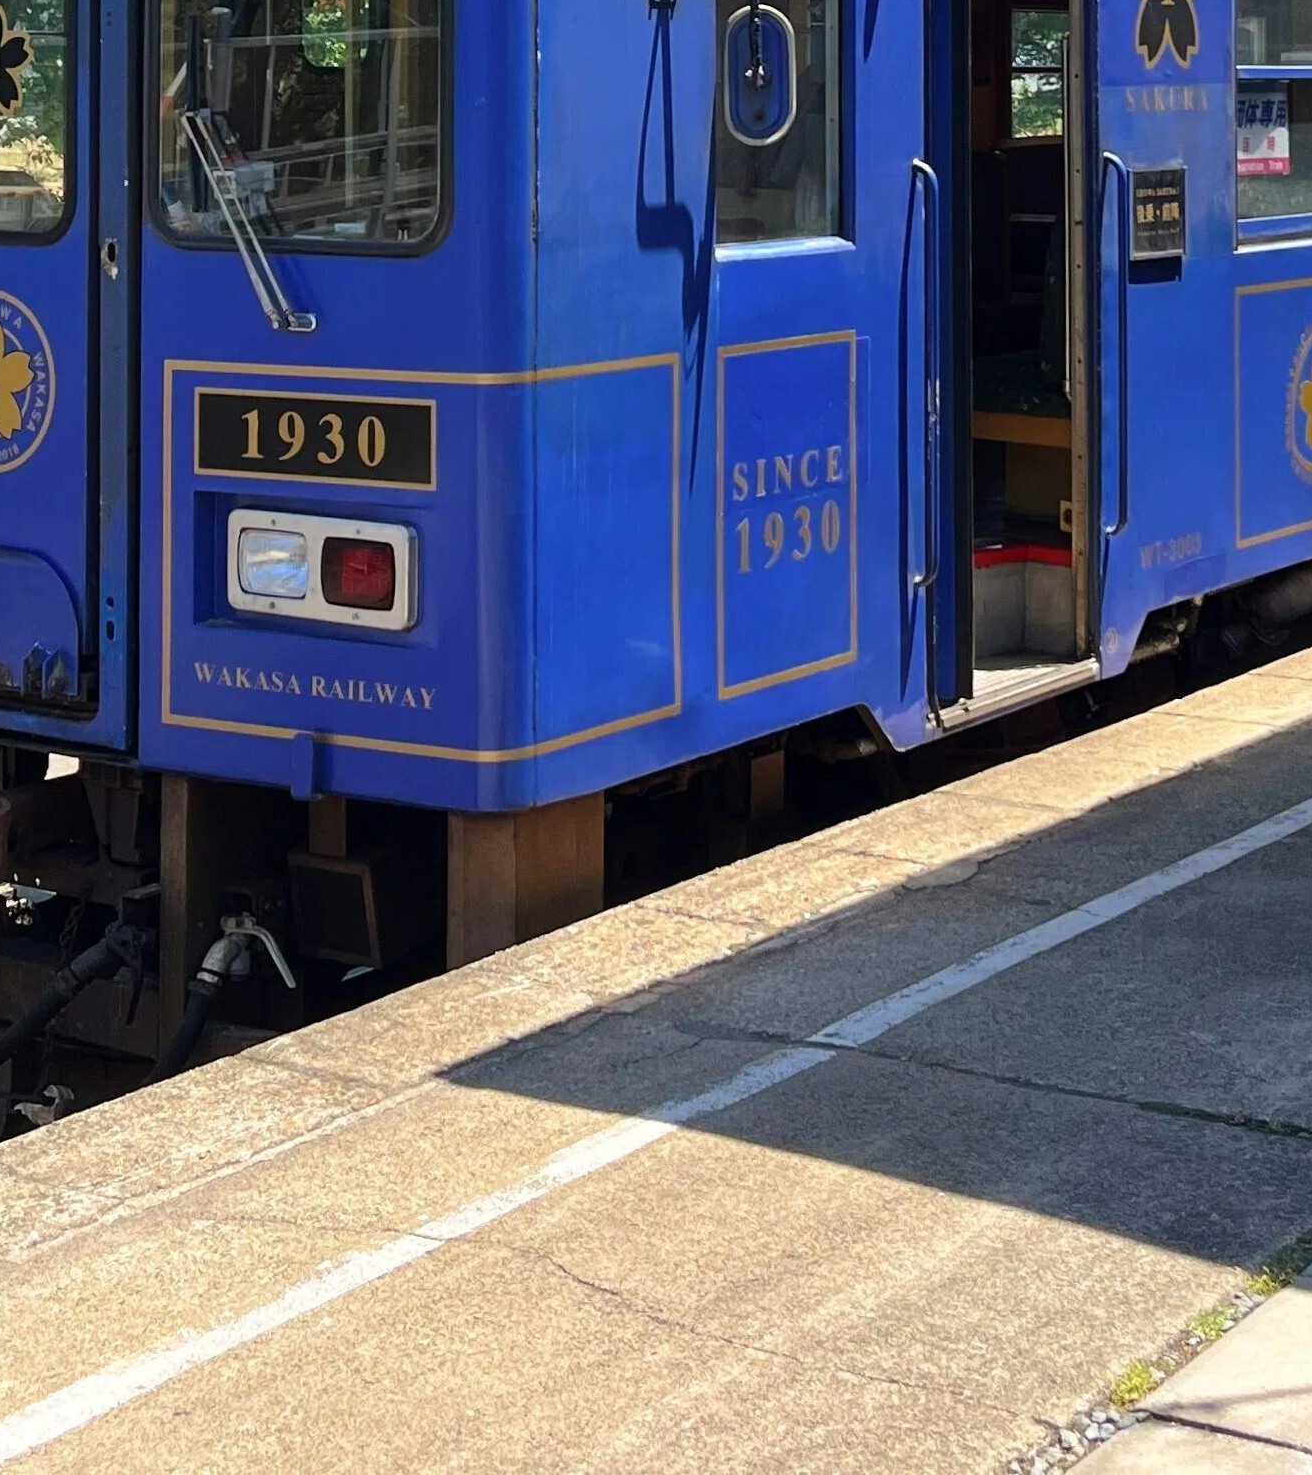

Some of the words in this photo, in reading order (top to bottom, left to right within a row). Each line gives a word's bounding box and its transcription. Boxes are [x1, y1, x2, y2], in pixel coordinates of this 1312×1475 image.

[1125, 86, 1209, 113] SAKURA
[26, 350, 45, 432] WAKASA
[241, 408, 386, 468] 1930
[732, 445, 842, 502] SINCE
[735, 498, 841, 574] 1930
[193, 661, 302, 696] WAKASA
[311, 675, 437, 711] RAILWAY
